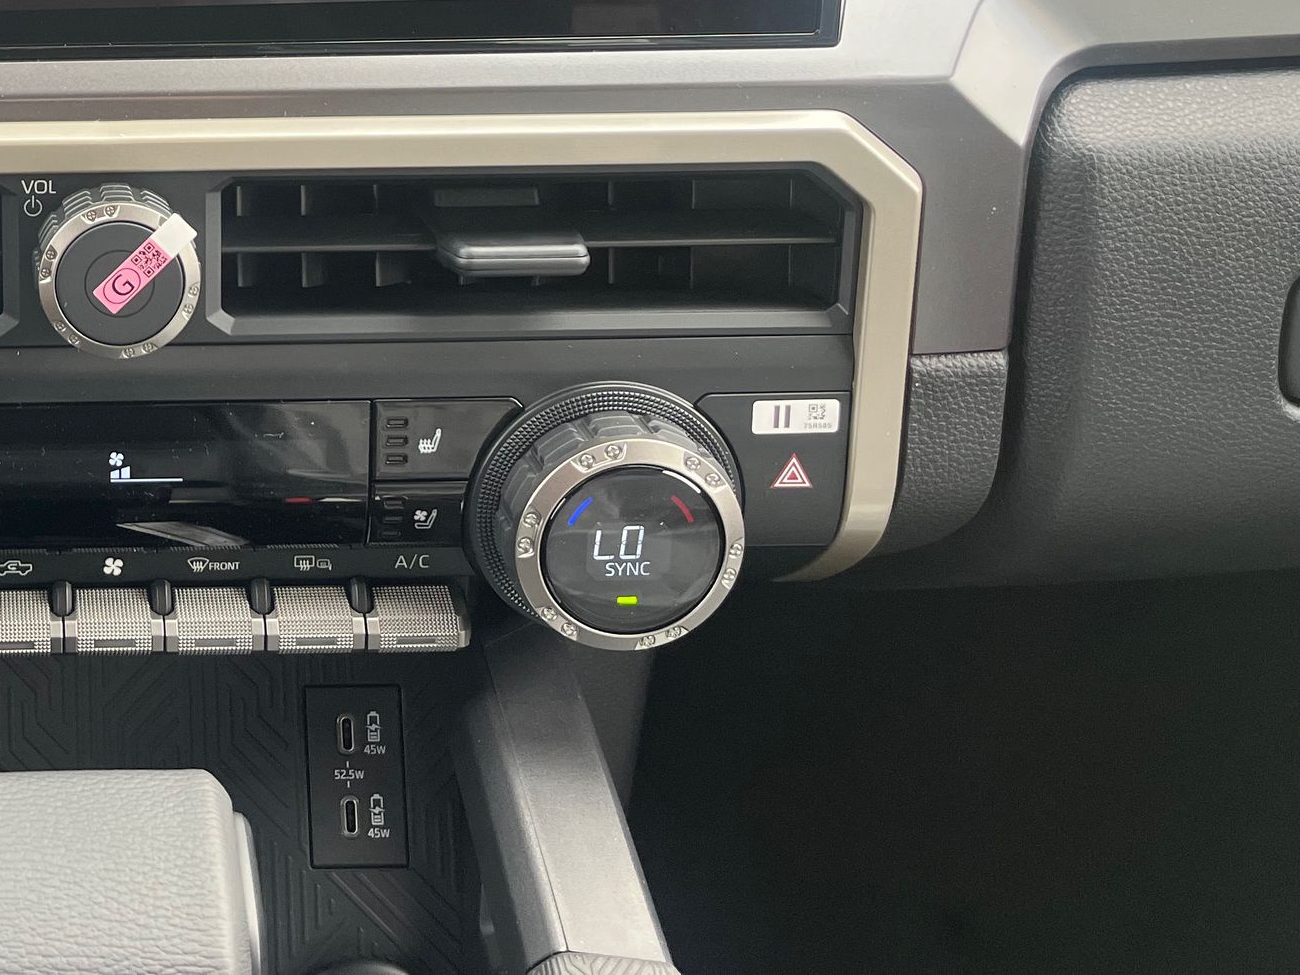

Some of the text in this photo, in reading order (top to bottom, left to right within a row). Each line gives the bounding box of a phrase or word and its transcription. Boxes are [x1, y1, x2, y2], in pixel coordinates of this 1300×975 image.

[21, 180, 56, 194] VOL
[111, 274, 135, 296] G
[209, 561, 240, 570] FRONT
[395, 555, 430, 569] A/C
[605, 562, 650, 576] SYNC
[364, 745, 386, 754] 45W
[334, 770, 364, 779] 52.5W
[368, 828, 390, 838] 45W
